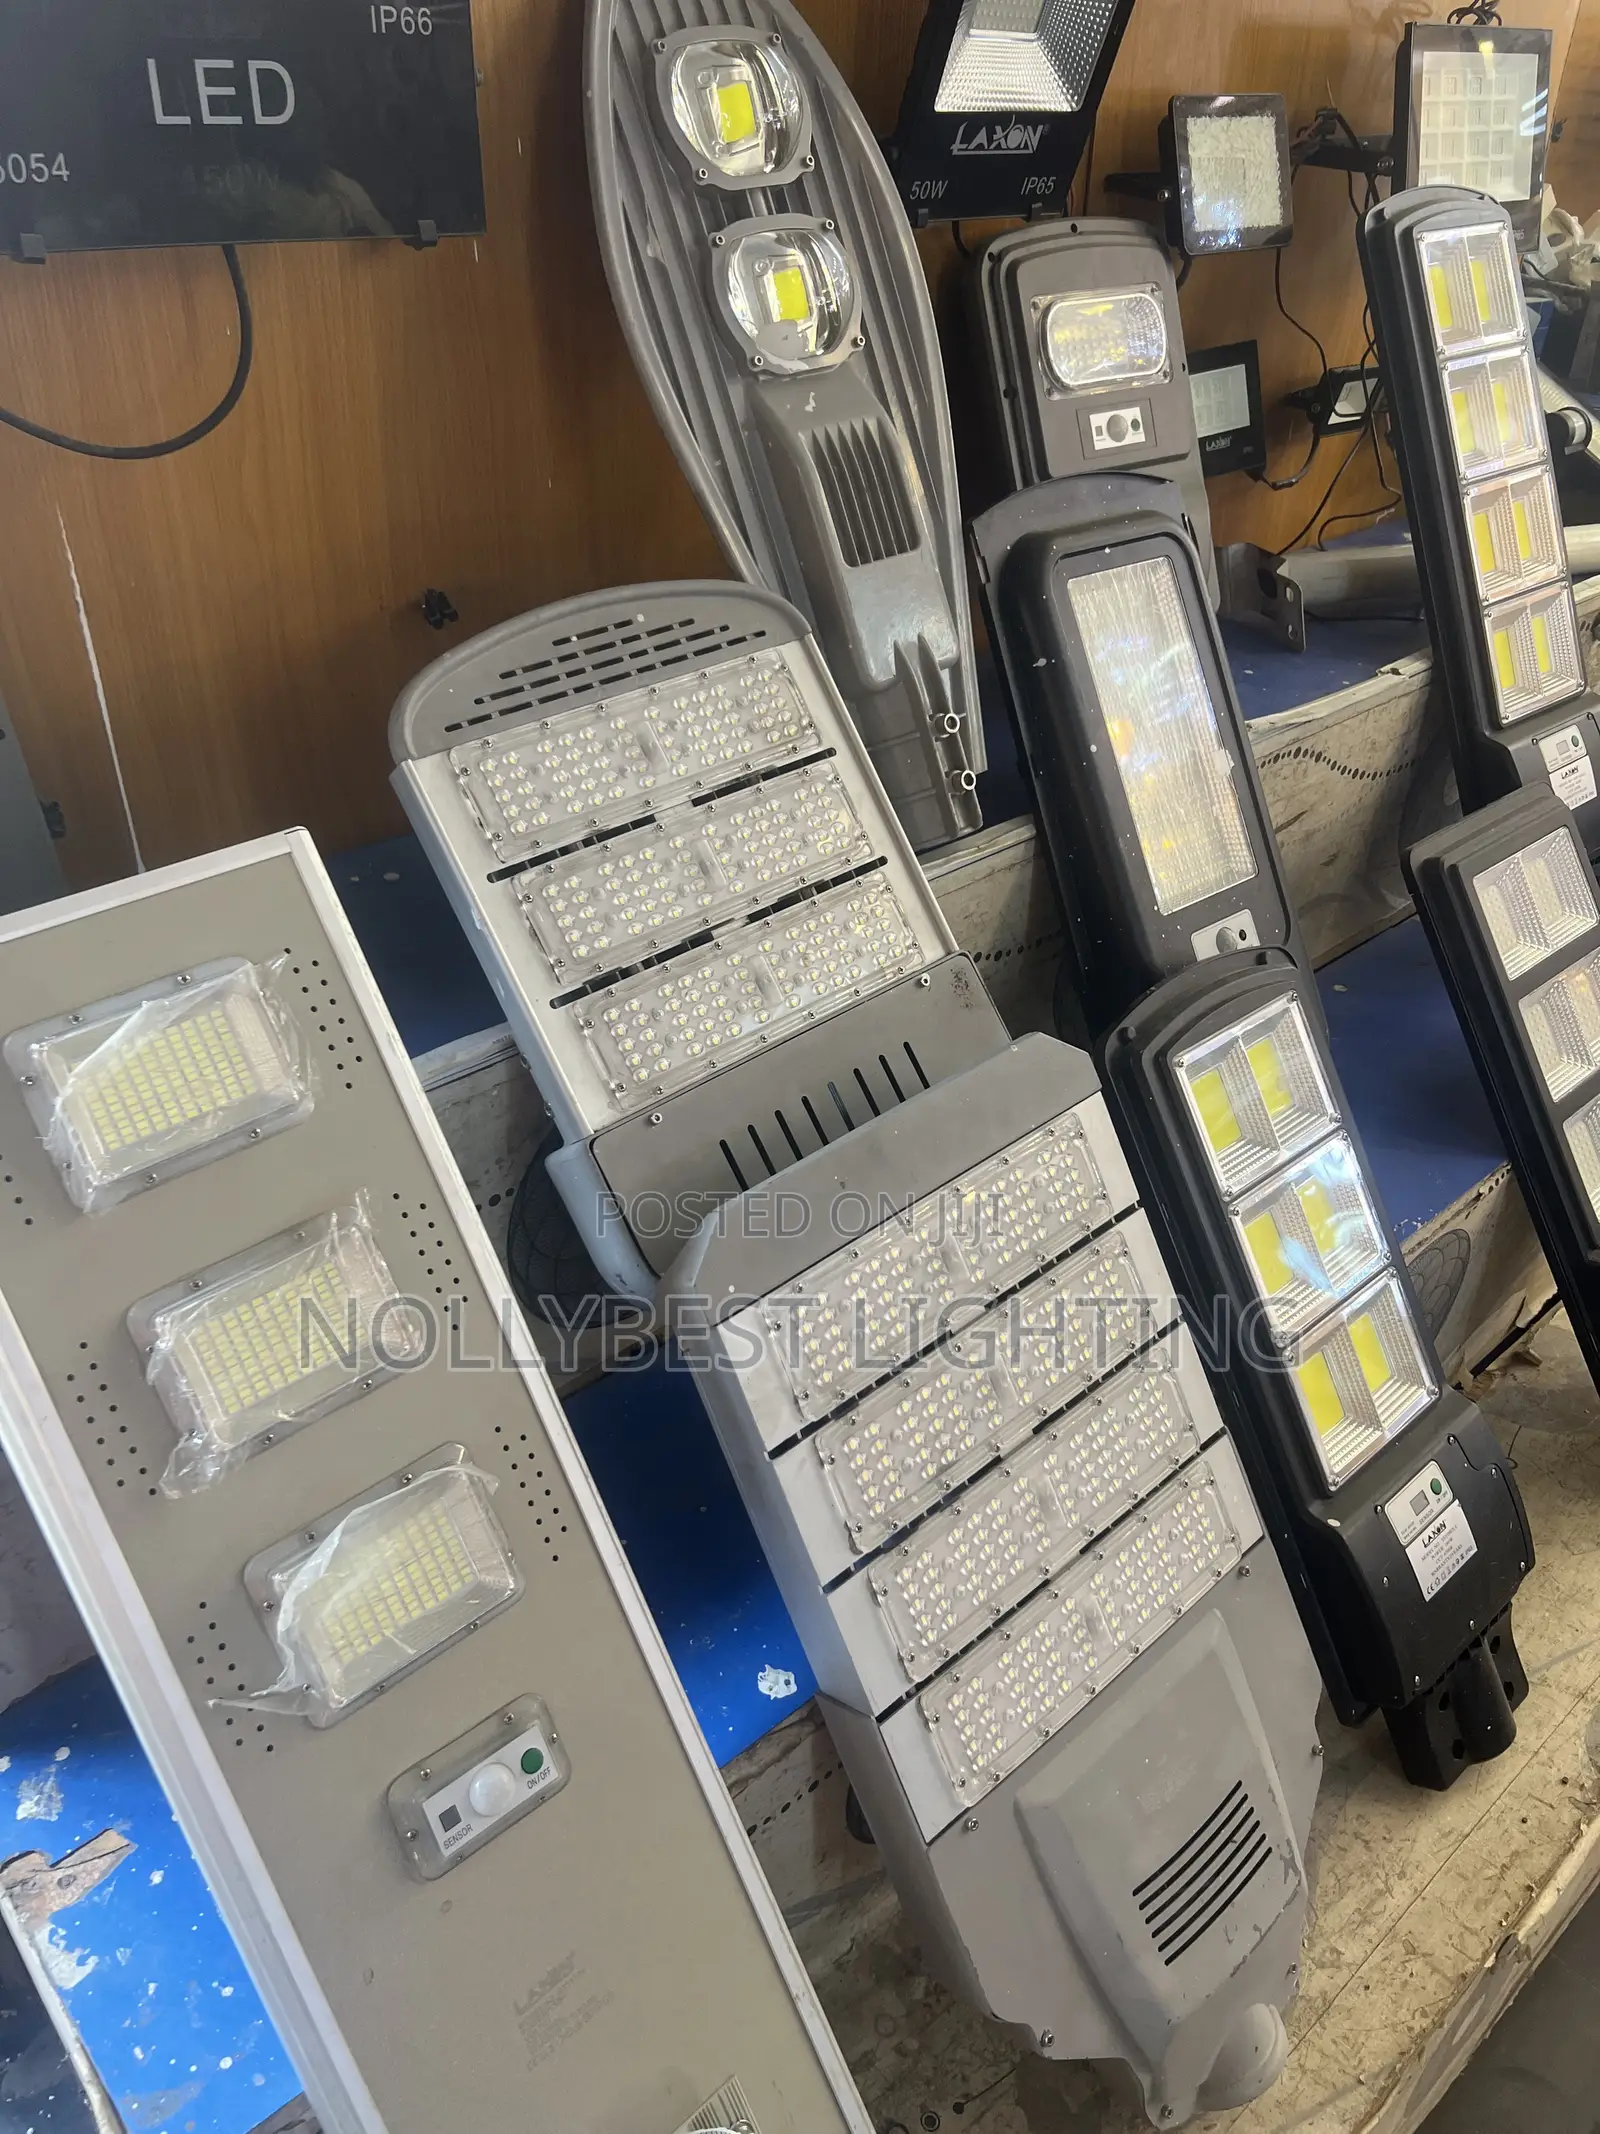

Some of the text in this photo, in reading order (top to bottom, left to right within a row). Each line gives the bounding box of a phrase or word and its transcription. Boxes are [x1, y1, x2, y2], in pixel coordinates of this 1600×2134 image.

[370, 5, 433, 36] IP66
[146, 57, 296, 125] LED
[950, 114, 1044, 156] LAXON
[909, 180, 949, 200] 50W
[1020, 176, 1057, 195] IP65
[527, 1766, 552, 1790] ON/OFF
[443, 1823, 474, 1851] SENSOR
